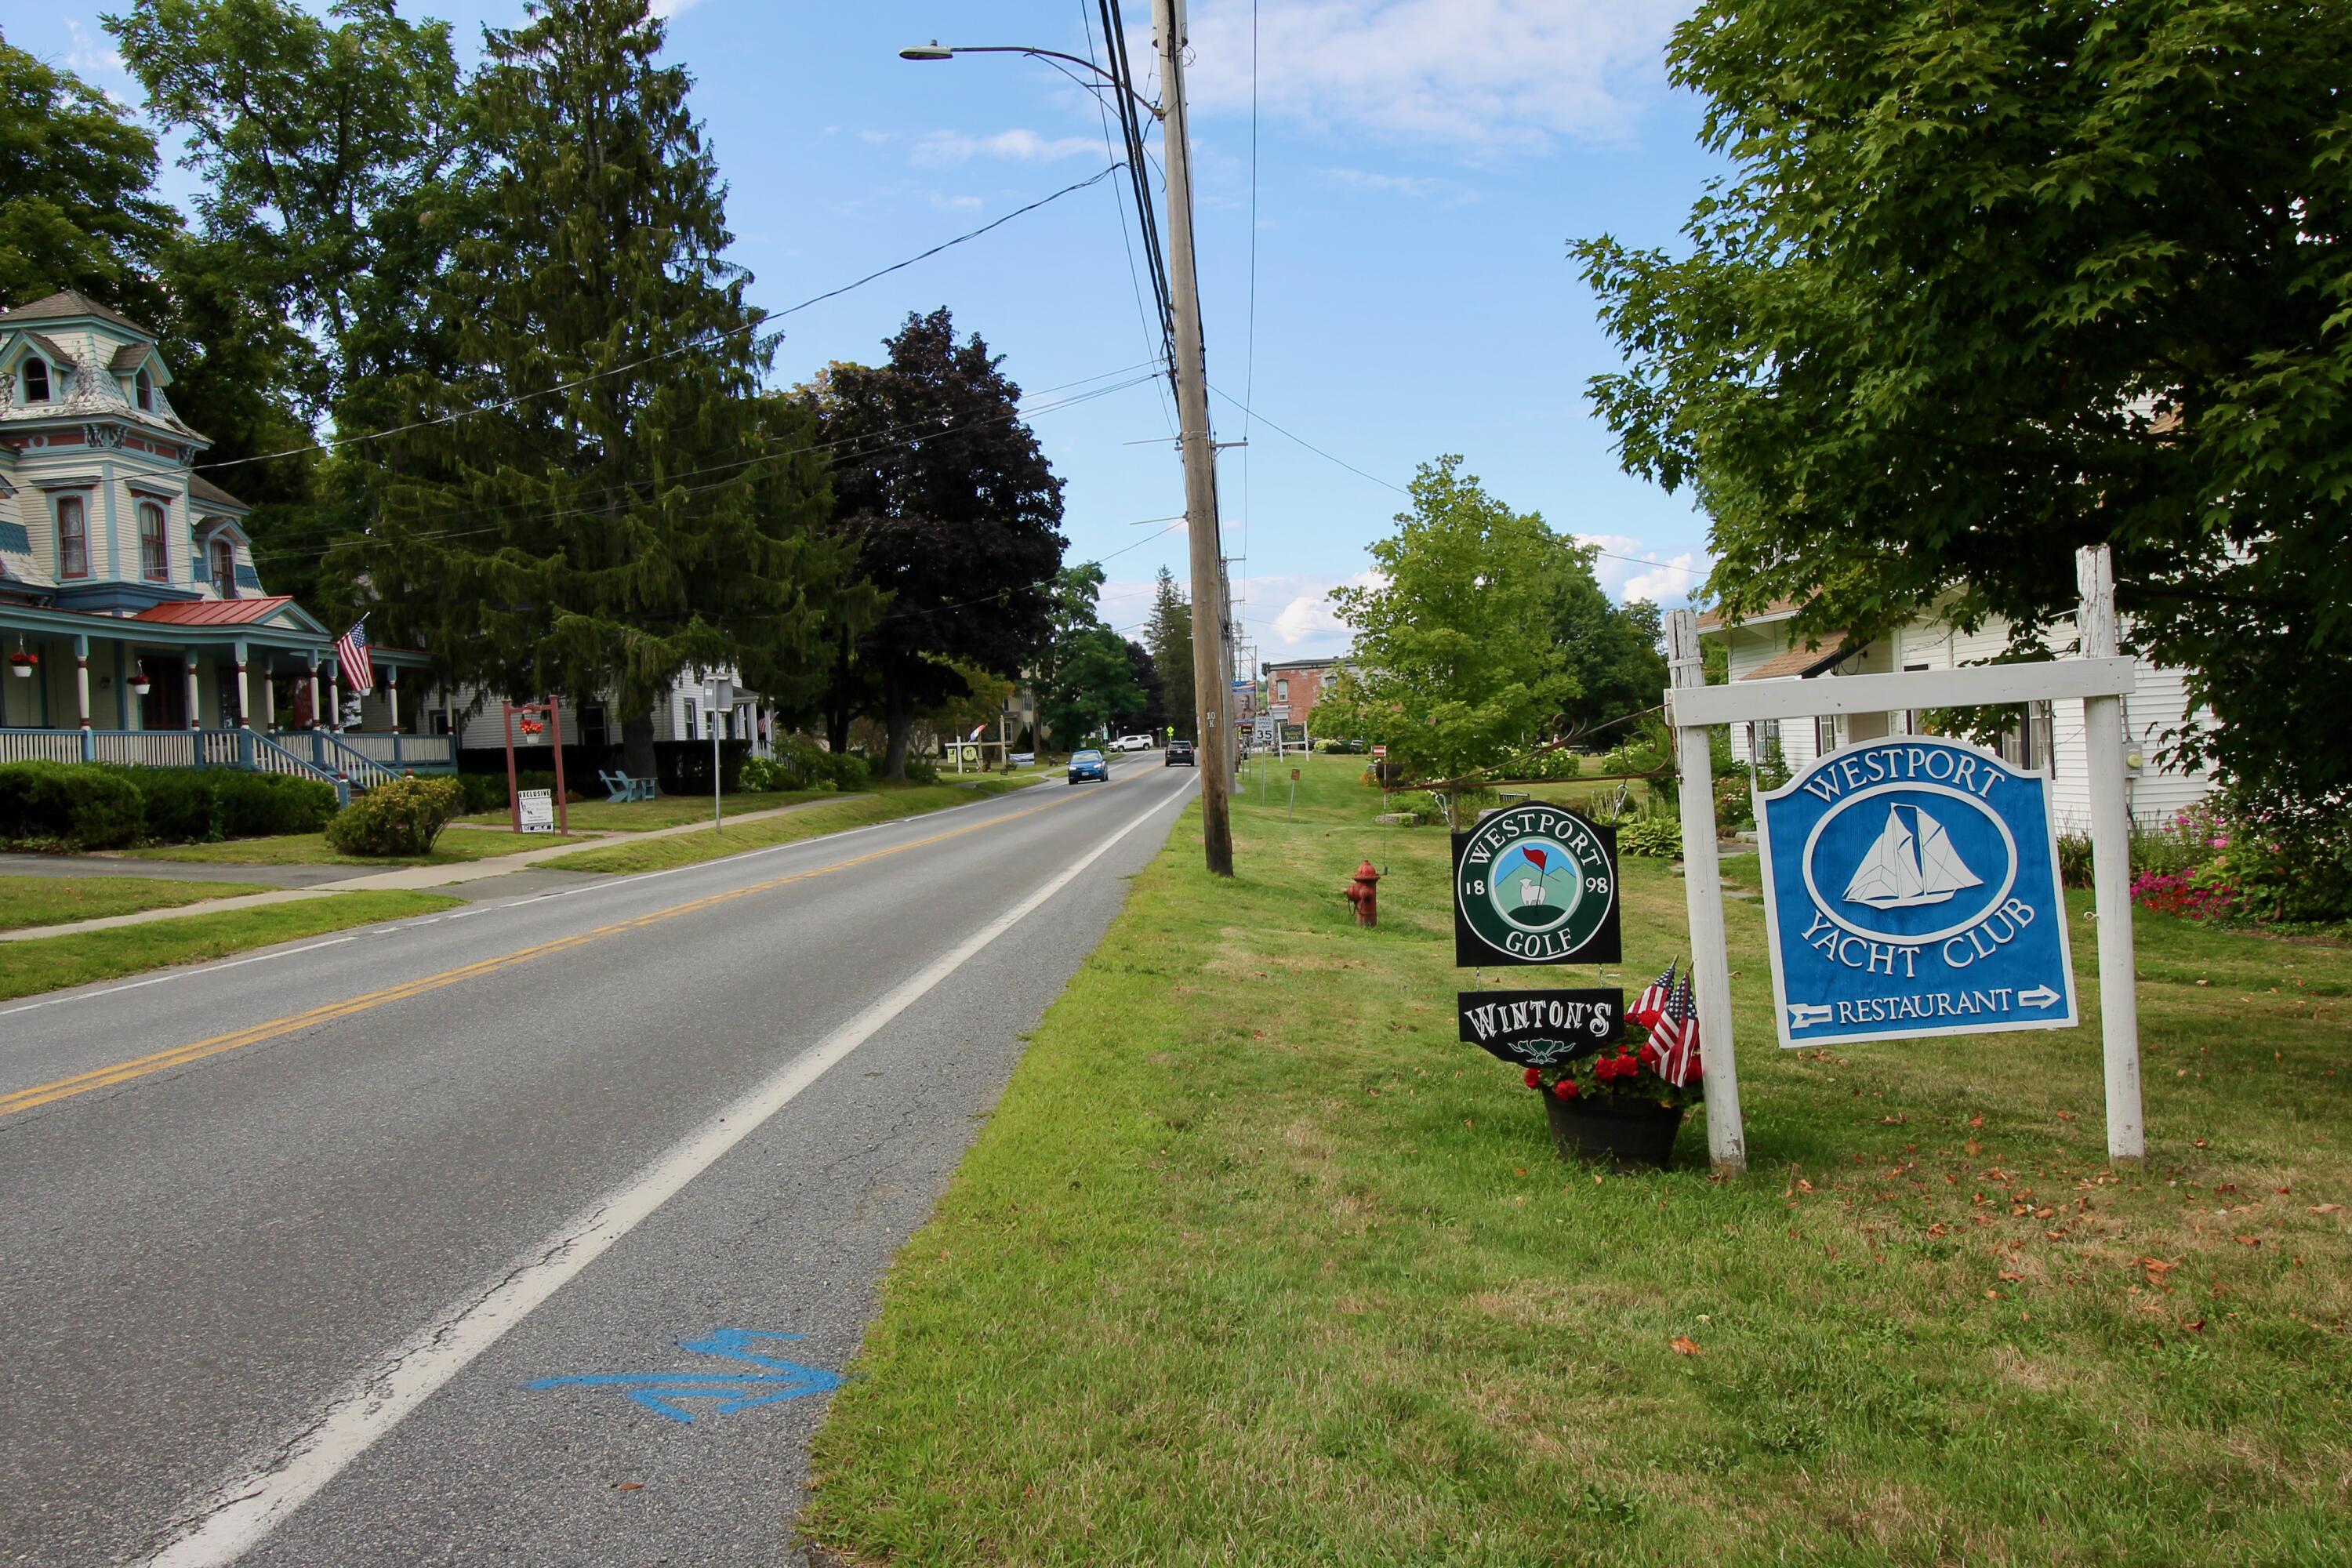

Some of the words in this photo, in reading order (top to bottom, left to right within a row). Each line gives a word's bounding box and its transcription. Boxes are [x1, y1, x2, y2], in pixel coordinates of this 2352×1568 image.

[1206, 711, 1215, 720] 10
[1257, 730, 1272, 739] 35
[1804, 747, 2006, 803] WESTPORT
[1468, 813, 1602, 867] WESTPORT
[1465, 880, 1486, 895] 18
[1585, 877, 1609, 895] 98
[1505, 927, 1573, 958] GOLF
[1801, 909, 1920, 978] YACHT
[1943, 897, 2035, 969] CLUB
[1465, 1000, 1612, 1040] WINTON'S
[1837, 988, 2013, 1025] RESTAURANT
